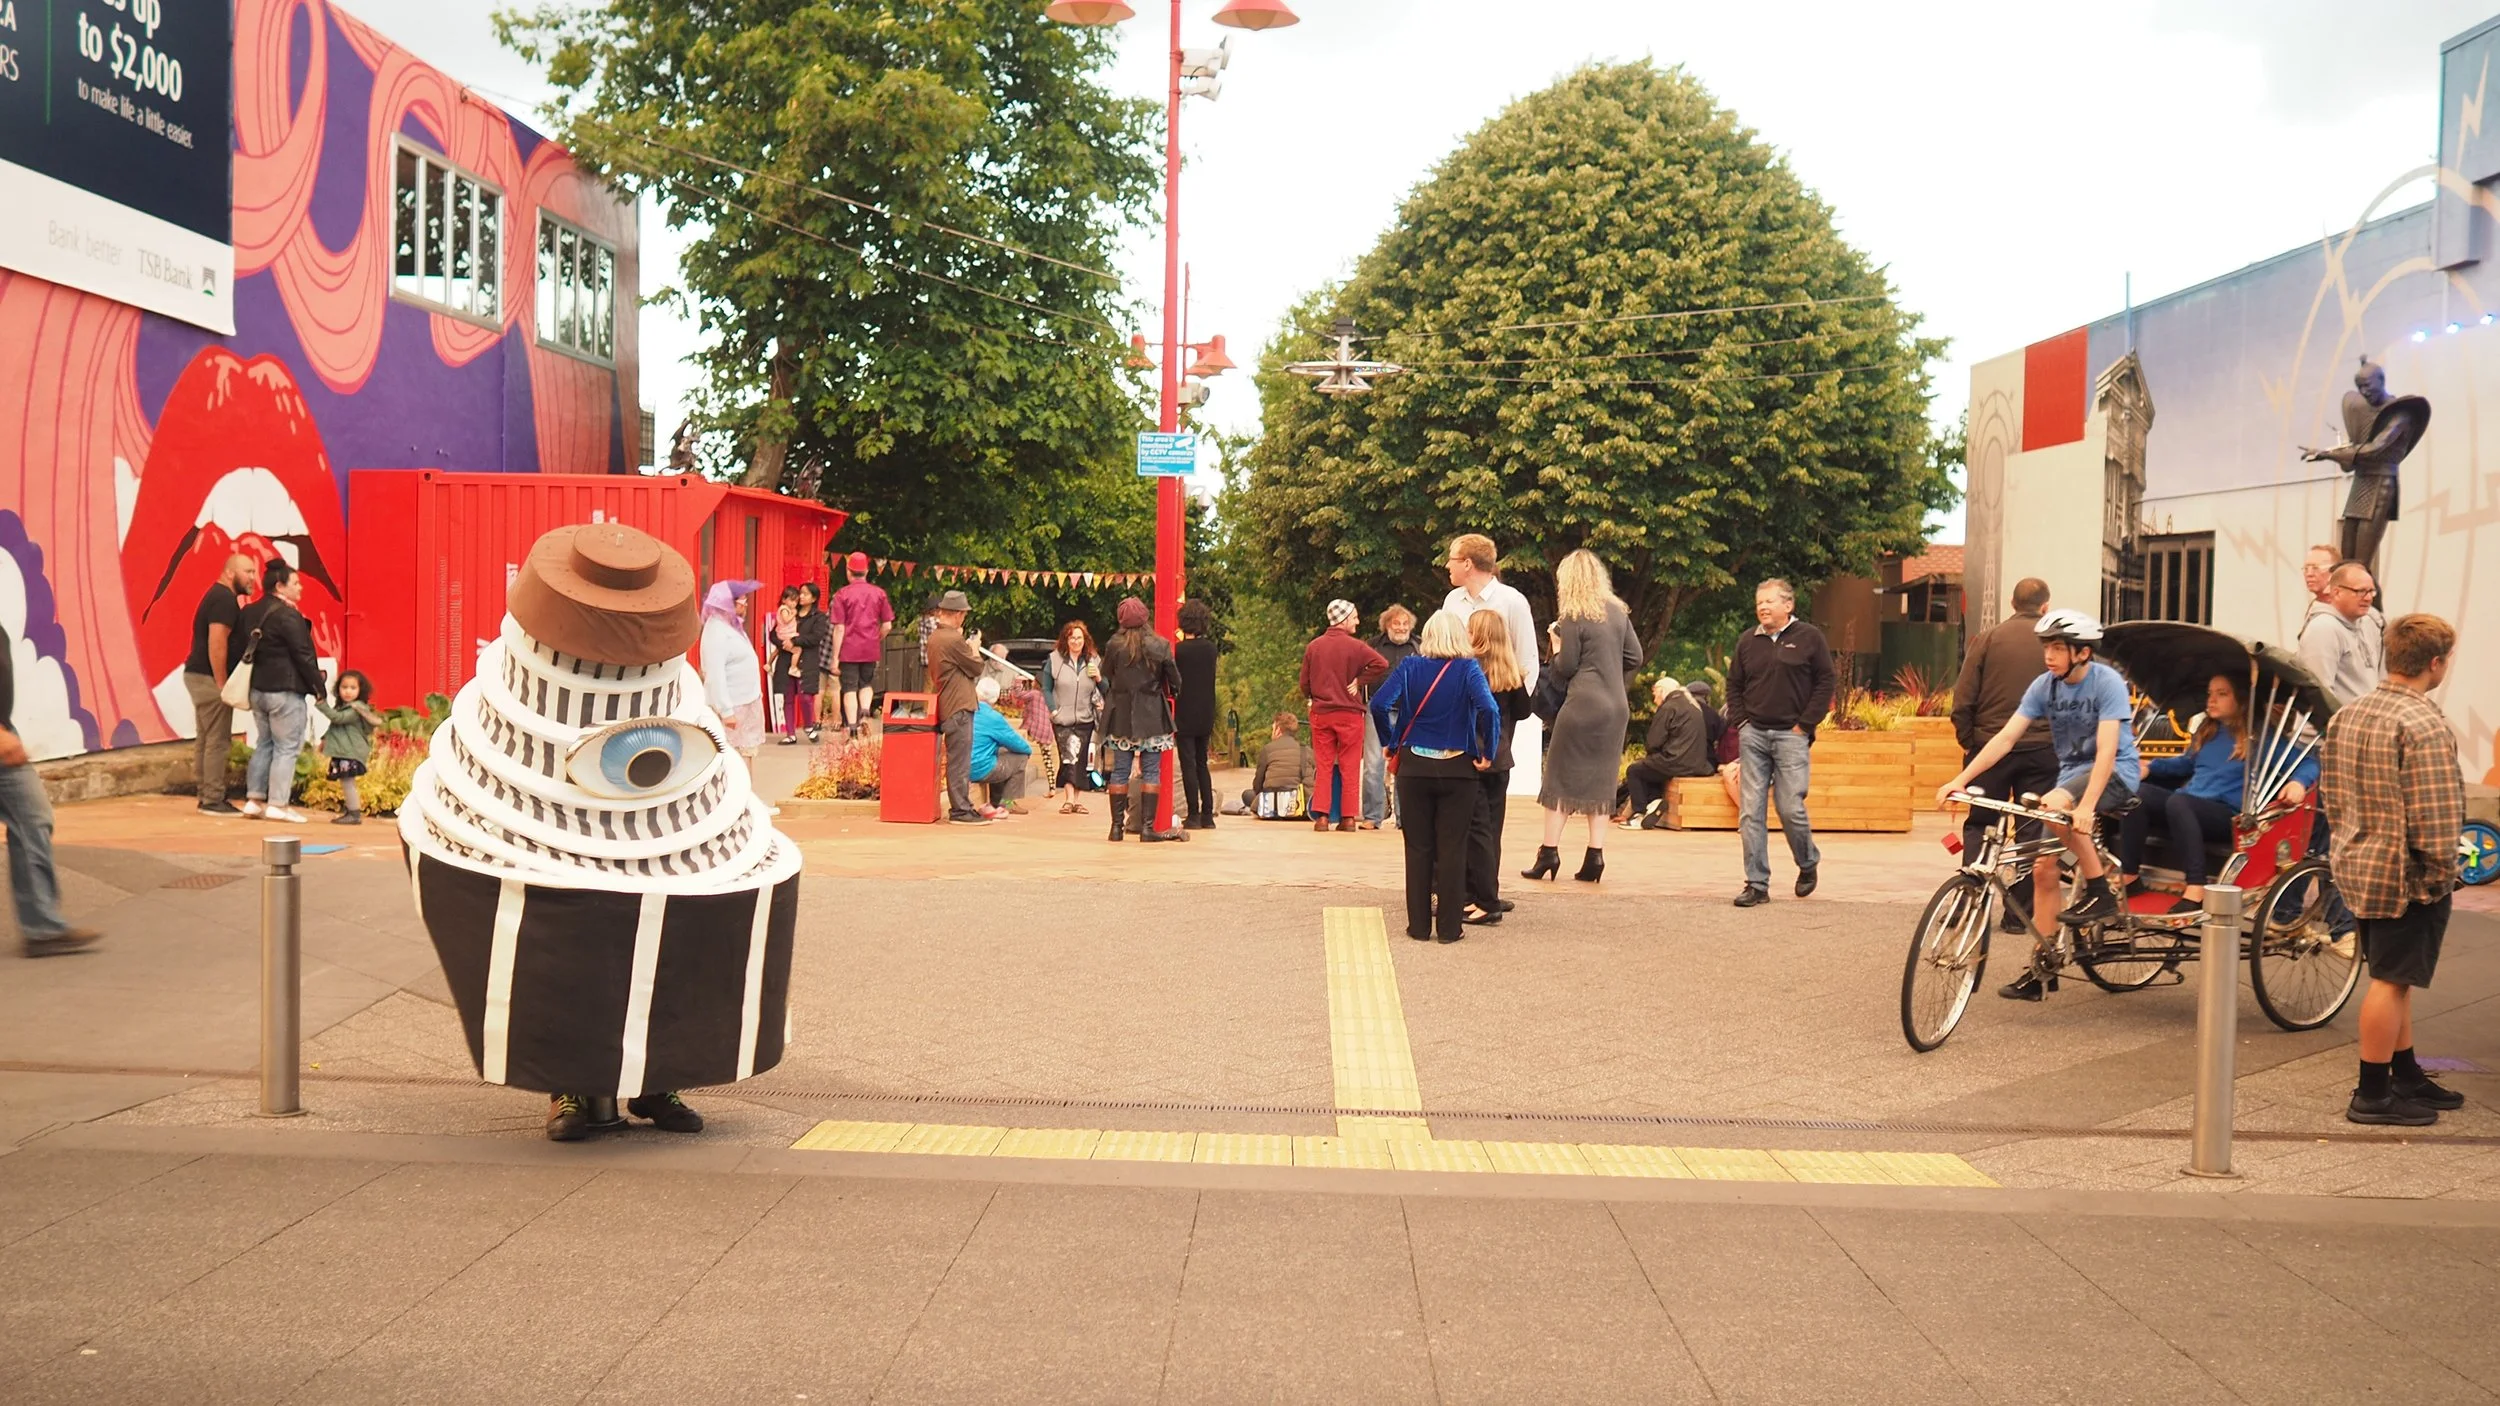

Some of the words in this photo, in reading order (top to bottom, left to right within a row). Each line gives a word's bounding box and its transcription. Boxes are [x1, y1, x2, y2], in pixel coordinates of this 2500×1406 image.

[78, 12, 103, 62] to
[110, 22, 182, 102] $2,000
[78, 78, 89, 100] to
[91, 86, 118, 114] make
[120, 95, 135, 122] life
[137, 108, 144, 126] a
[146, 106, 165, 136] little
[48, 219, 80, 252] Bank
[86, 230, 123, 266] better
[138, 248, 161, 280] TSB
[164, 258, 193, 290] Bank
